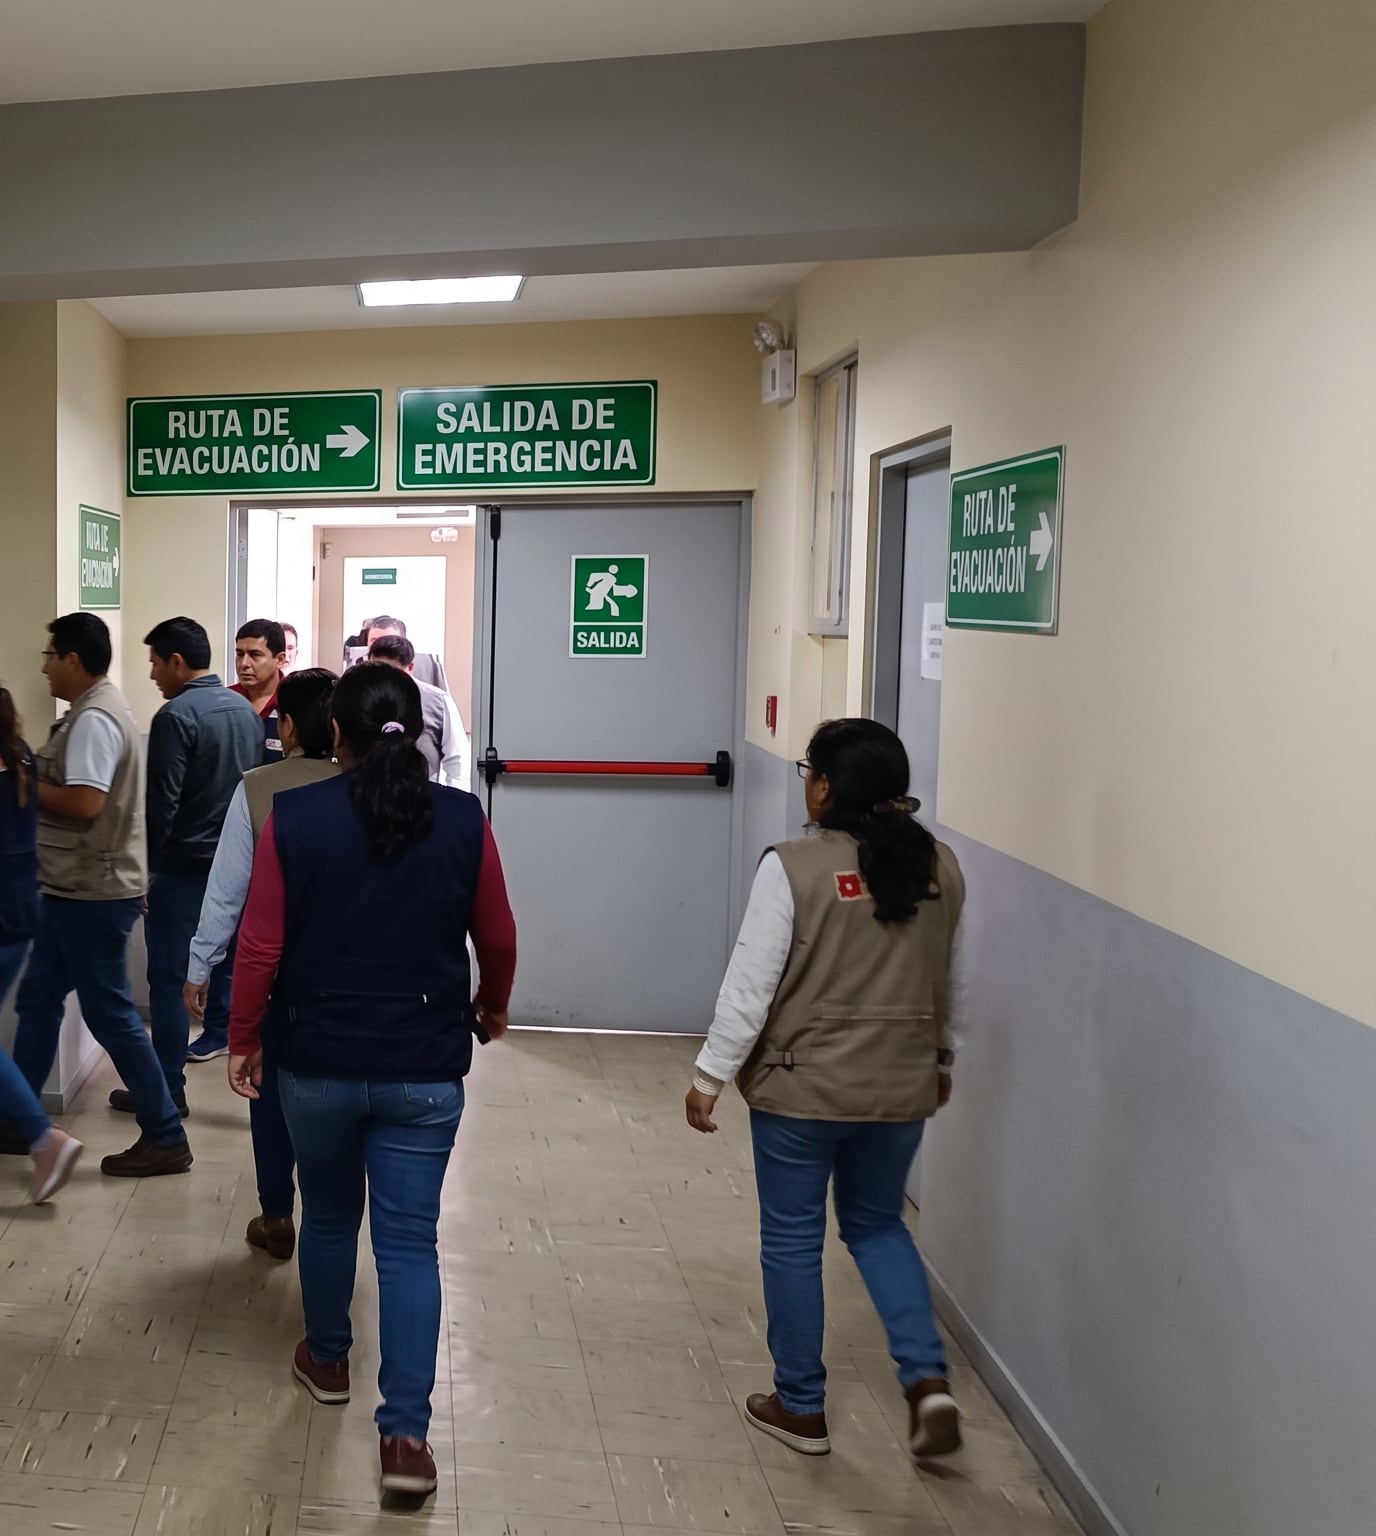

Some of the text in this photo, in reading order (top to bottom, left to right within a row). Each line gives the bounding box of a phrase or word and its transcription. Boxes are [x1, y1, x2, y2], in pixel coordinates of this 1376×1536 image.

[168, 407, 290, 439] RUTA DE
[436, 398, 615, 434] SALIDA DE
[137, 437, 320, 476] EVACUACIÓN
[415, 439, 637, 475] EMERGENCIA
[963, 484, 1017, 537] RUTA DE
[950, 535, 1026, 593] EVACUACIÓN
[577, 631, 639, 648] SALIDA
